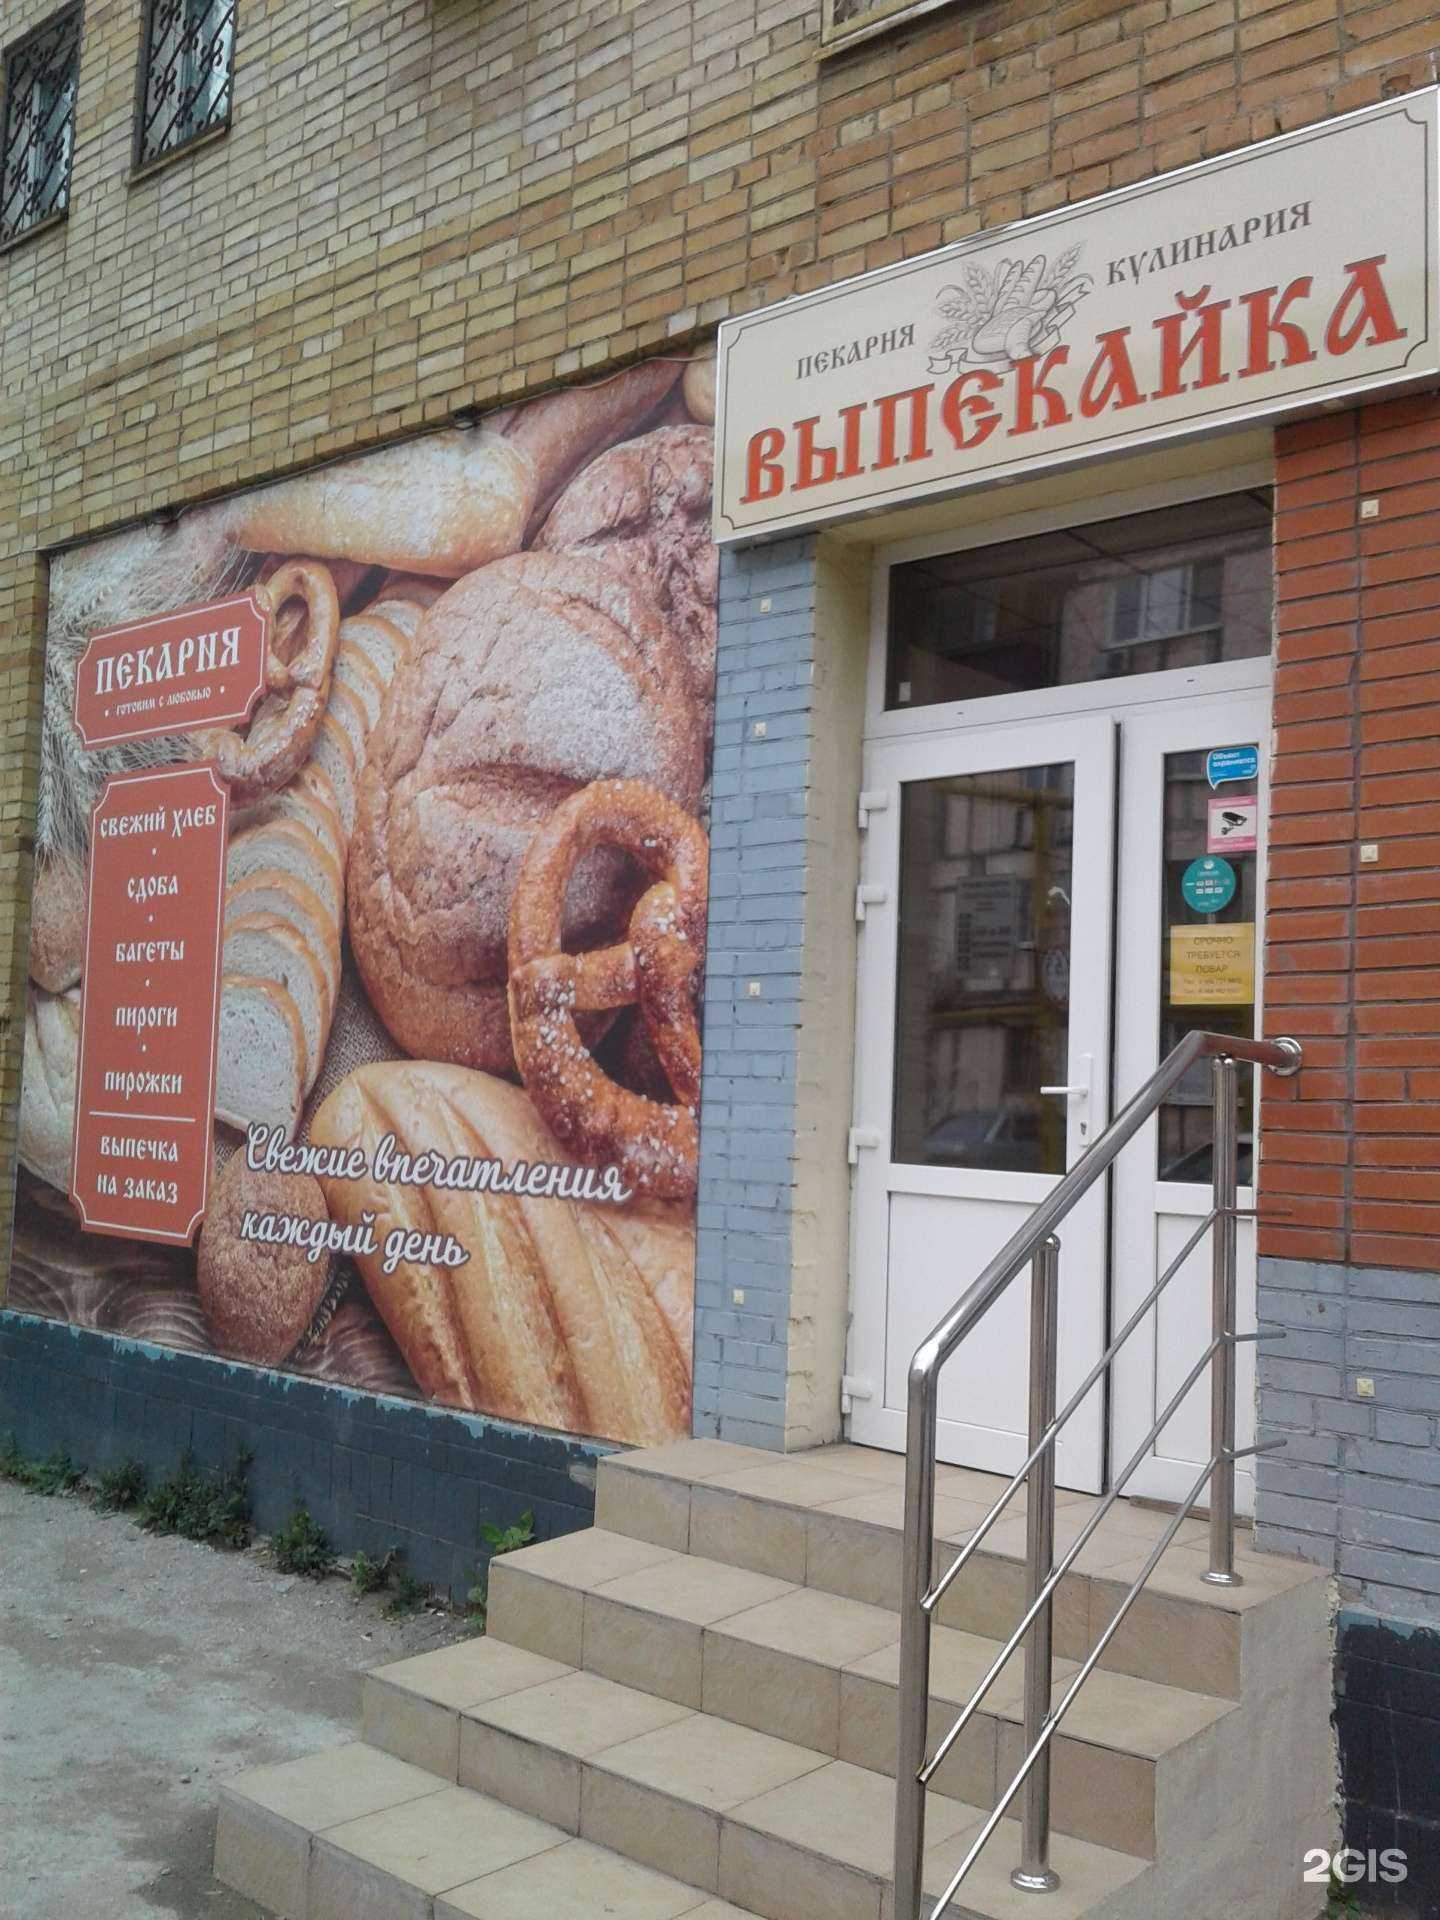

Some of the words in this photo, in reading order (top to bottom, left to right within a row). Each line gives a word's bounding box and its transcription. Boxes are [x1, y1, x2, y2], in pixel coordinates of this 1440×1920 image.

[1106, 200, 1313, 286] КУЛИНАРИЯ
[795, 322, 916, 379] ПЕКАРНЯ
[739, 254, 1408, 505] ВЫПЕКАЙКА
[94, 626, 242, 695] ПЕКАРНЯ
[100, 806, 166, 838] СВЕЖИЙ
[171, 804, 217, 838] ХЛЕБ
[127, 875, 179, 903] СДОБА
[115, 940, 185, 963] БАГЕТЫ
[115, 1006, 178, 1035] ПИРОГИ
[104, 1070, 183, 1100] ПИРОЖКИ
[99, 1135, 179, 1163] ВЫПЕЧКА
[246, 1123, 368, 1179] Свежие
[373, 1133, 634, 1202] впечатления
[97, 1173, 118, 1196] НА
[123, 1177, 178, 1204] ЗАКАЗ
[240, 1211, 378, 1262] каждый
[383, 1227, 470, 1275] день
